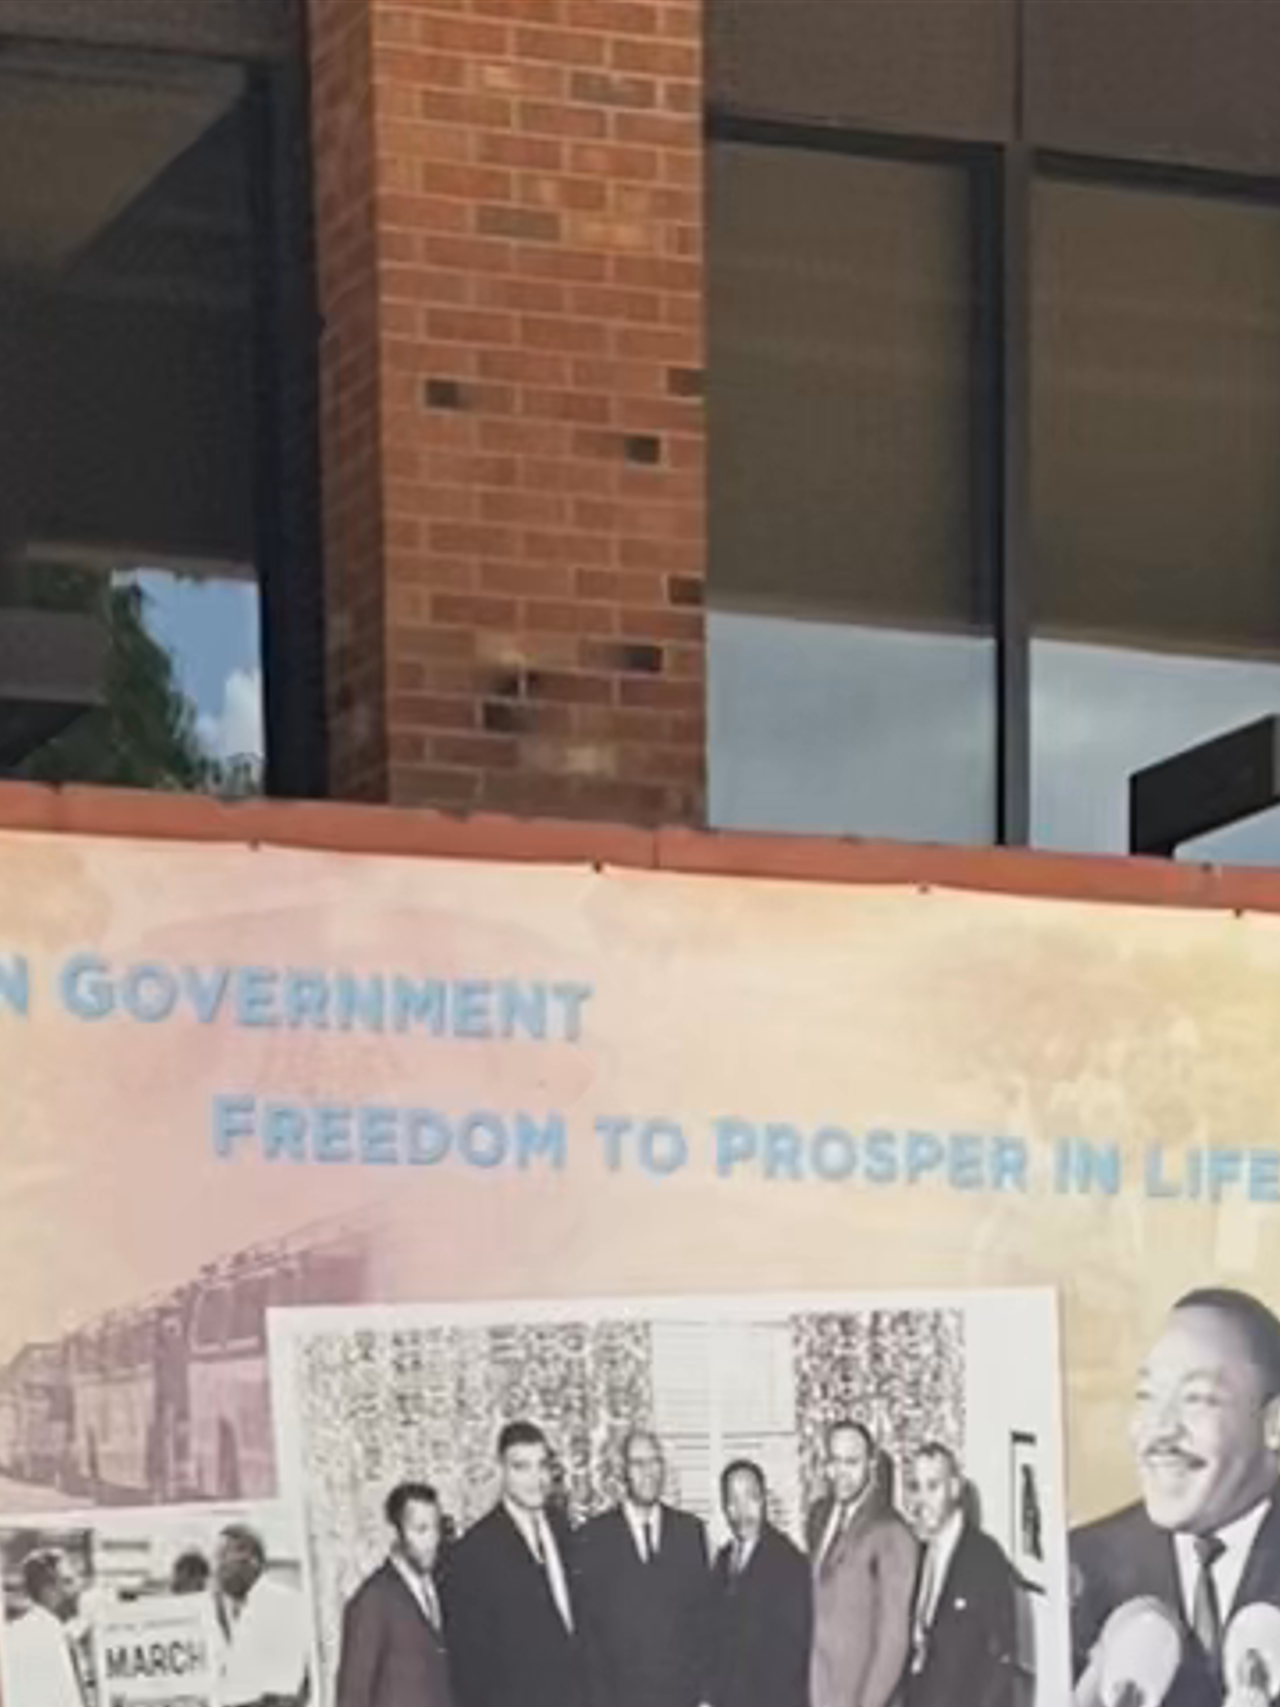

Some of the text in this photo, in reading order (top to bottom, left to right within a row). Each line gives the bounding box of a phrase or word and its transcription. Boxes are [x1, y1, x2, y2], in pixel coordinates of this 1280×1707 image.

[59, 953, 594, 1042] GOVERNMENT
[210, 1094, 567, 1170] FREEDOM
[594, 1116, 690, 1176] TO
[713, 1116, 1033, 1193] PROSPER
[1055, 1136, 1121, 1197] IN
[106, 1641, 207, 1678] MARCH
